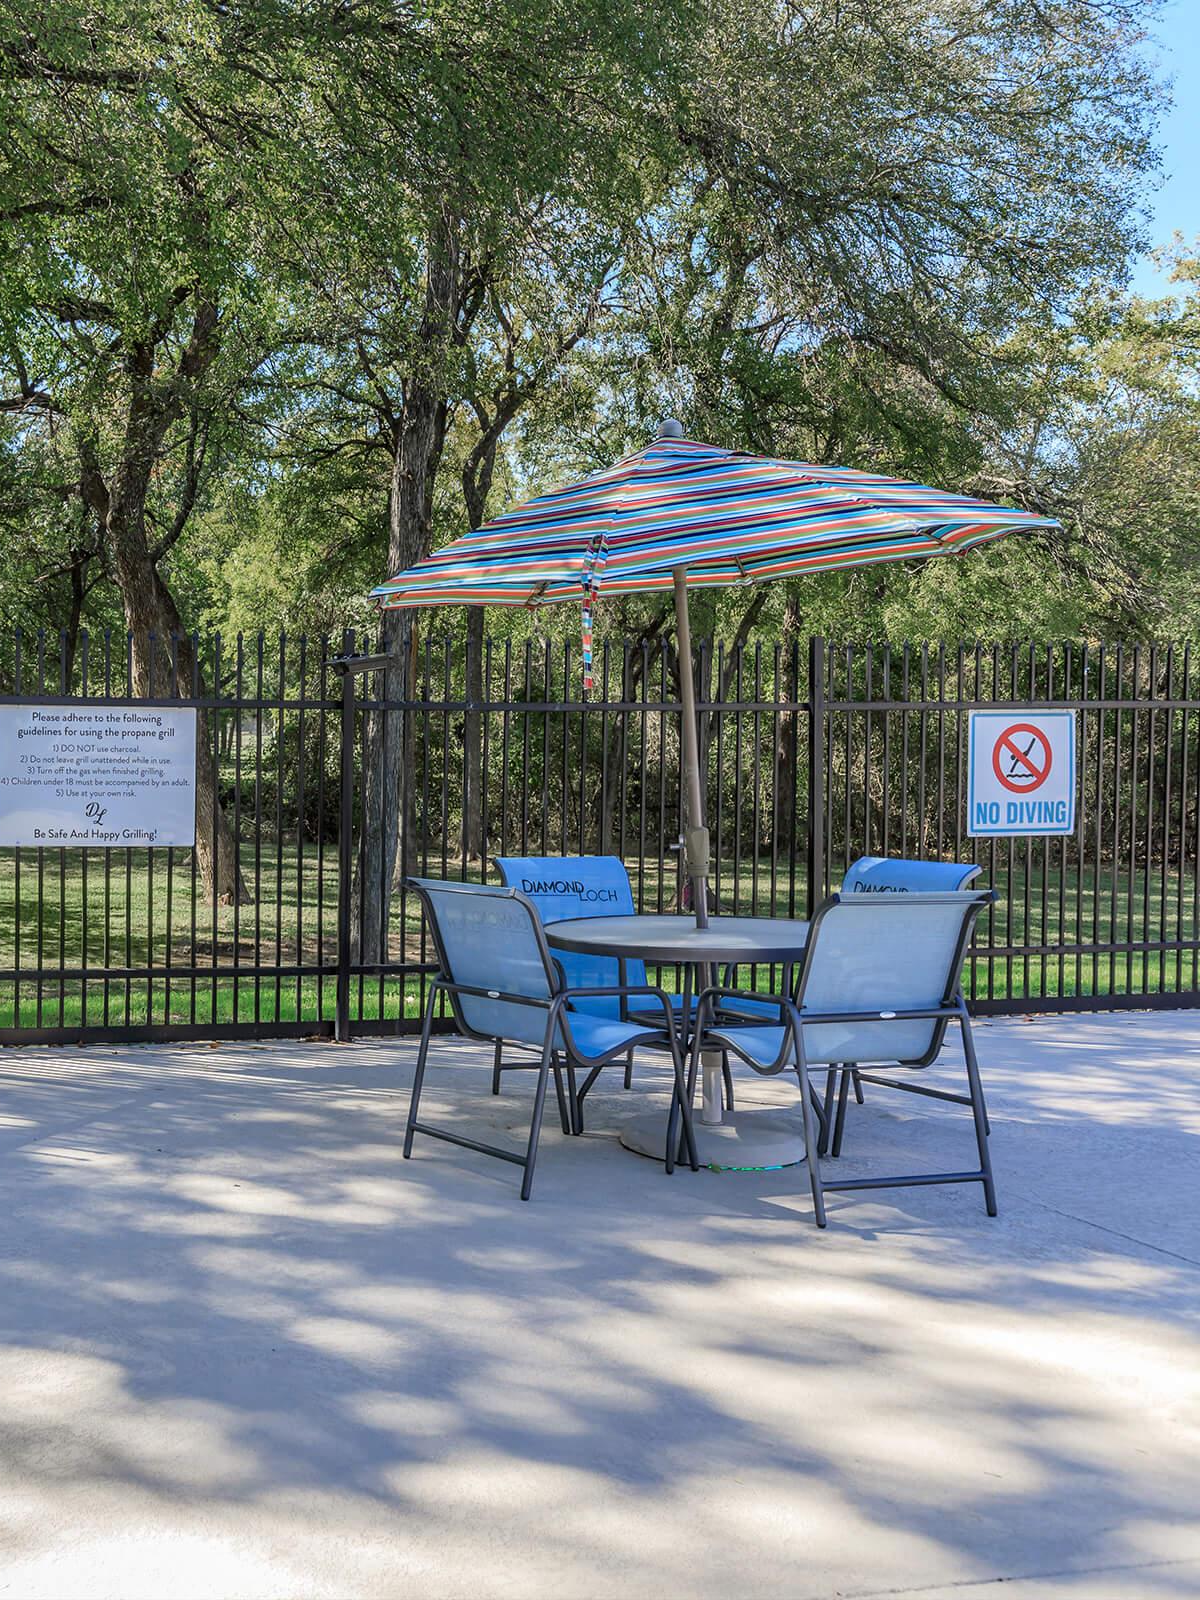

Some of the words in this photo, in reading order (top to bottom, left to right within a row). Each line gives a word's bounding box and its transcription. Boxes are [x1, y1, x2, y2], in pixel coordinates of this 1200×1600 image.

[32, 711, 60, 722] Please
[62, 712, 92, 722] adhere
[94, 715, 104, 723] to
[106, 713, 121, 723] the
[123, 713, 162, 727] following
[17, 726, 62, 739] guidelines
[64, 726, 77, 736] for
[79, 728, 103, 740] using
[105, 728, 119, 737] the
[121, 730, 157, 740] propane
[158, 728, 175, 740] grill
[52, 744, 59, 753] 1)
[61, 744, 75, 752] DO
[77, 744, 95, 752] NOT
[20, 755, 28, 764] 2)
[30, 755, 41, 763] Do
[76, 756, 89, 766] grill
[90, 756, 130, 764] unattended
[26, 766, 35, 775] 3)
[36, 766, 52, 774] Turn
[54, 766, 65, 774] off
[66, 767, 77, 775] the
[79, 768, 90, 777] gas
[112, 767, 139, 775] finished
[0, 777, 9, 785] 4)
[11, 777, 41, 785] Children
[43, 778, 63, 786] under
[75, 778, 93, 786] must
[104, 779, 150, 788] accompanied
[151, 779, 159, 788] by
[171, 778, 190, 786] adult.
[55, 789, 64, 797] 5)
[65, 789, 79, 797] Use
[89, 791, 105, 799] your
[976, 802, 1000, 824] NO
[1006, 801, 1066, 824] DIVING
[34, 829, 46, 838] Be
[48, 829, 68, 838] Safe
[70, 829, 88, 838] And
[91, 829, 120, 841] Happy
[122, 829, 157, 841] Grilling!
[521, 879, 585, 893] DIAMOND
[579, 889, 618, 901] LOCH
